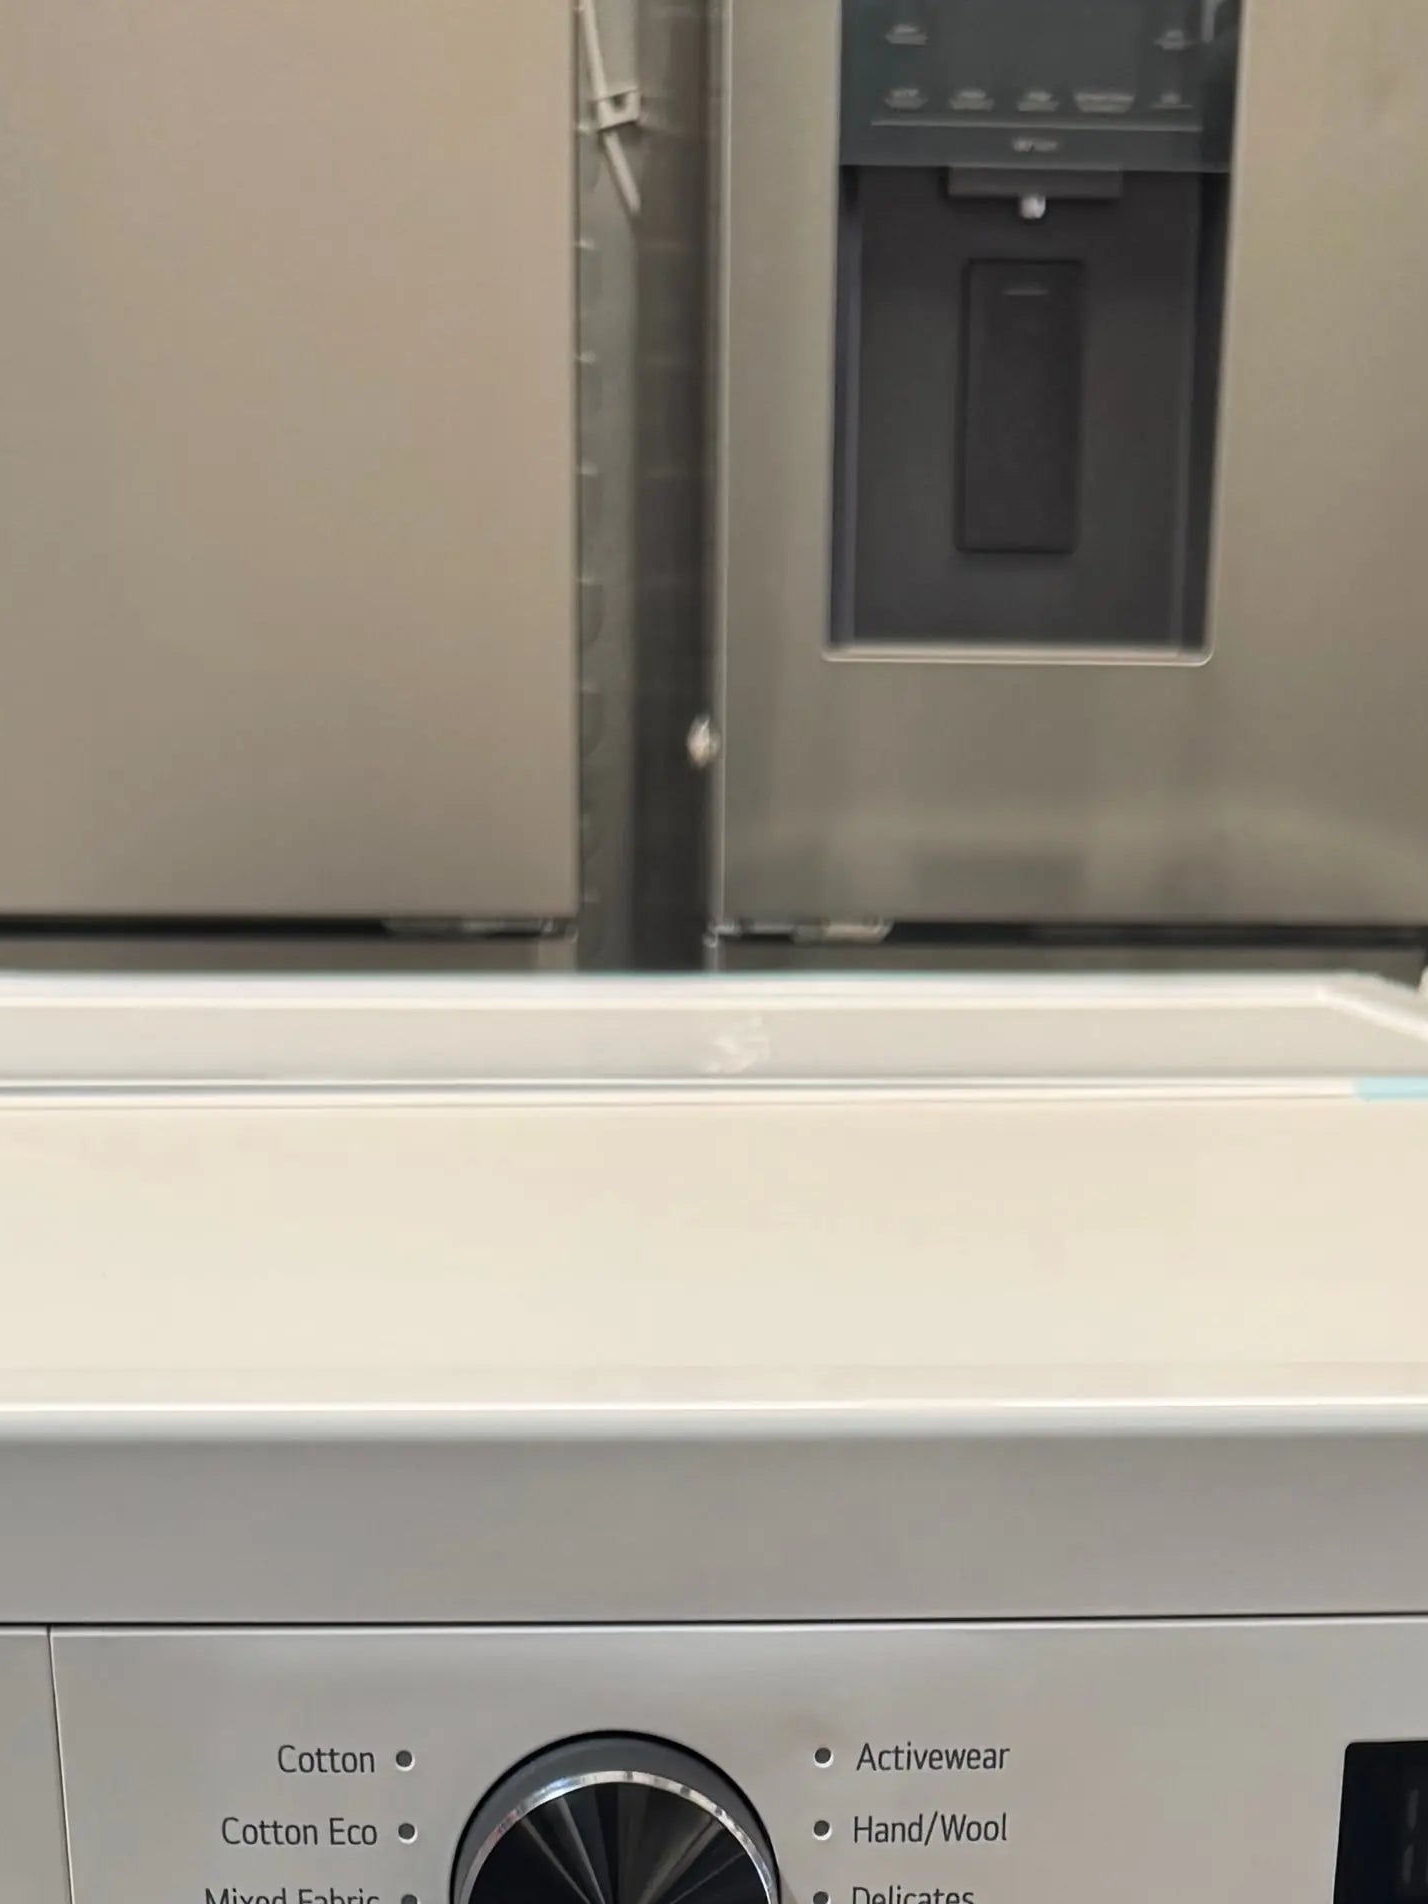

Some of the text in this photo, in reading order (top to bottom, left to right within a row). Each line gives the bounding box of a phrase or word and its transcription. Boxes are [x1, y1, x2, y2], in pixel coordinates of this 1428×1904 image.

[277, 1744, 376, 1773] Cotton
[855, 1742, 1011, 1772] Activewear
[221, 1816, 378, 1845] Cotton Eco
[852, 1813, 1009, 1847] Hand/Wool
